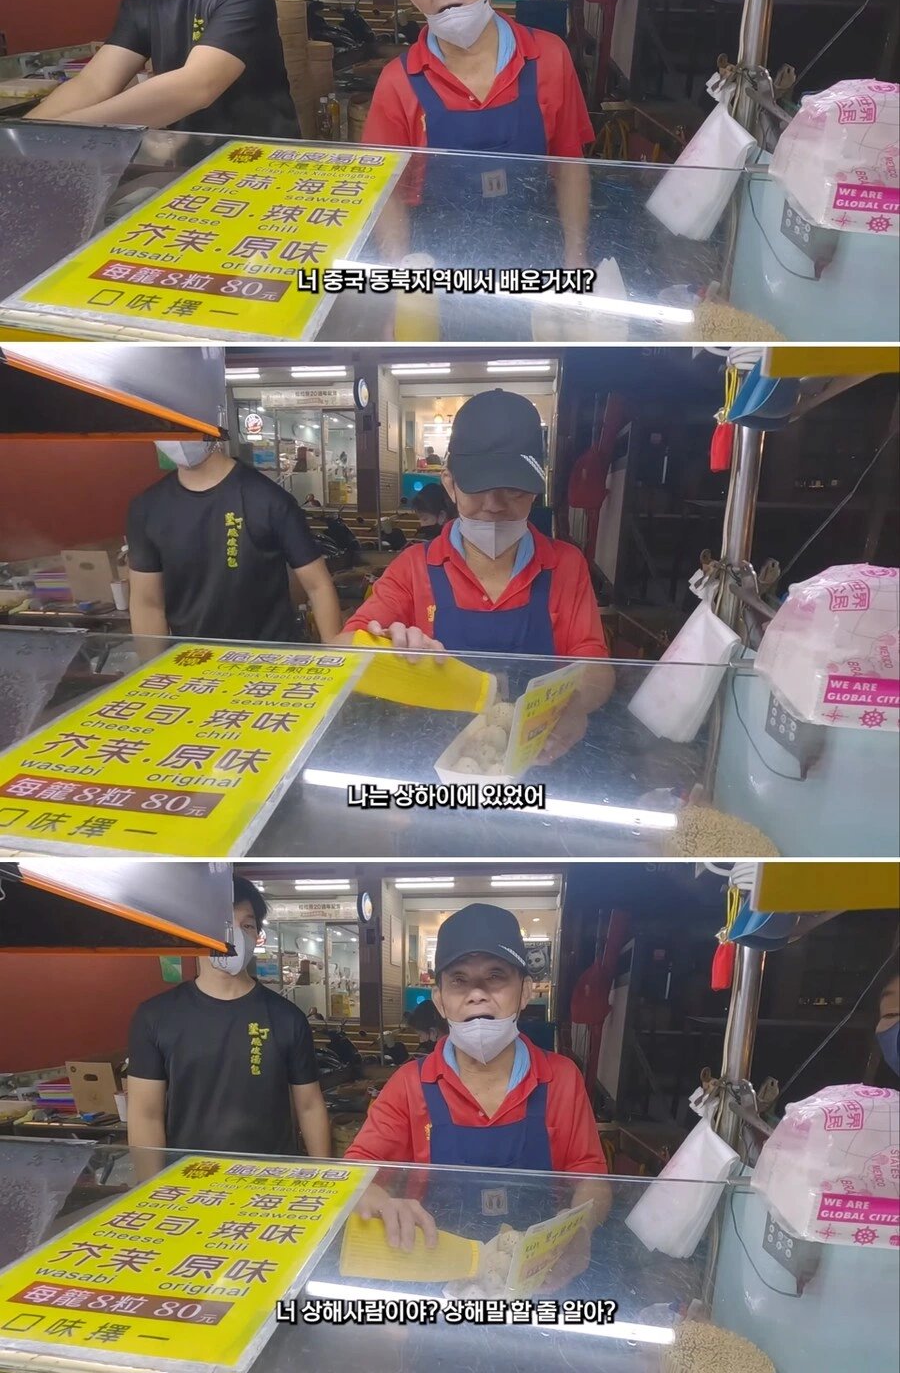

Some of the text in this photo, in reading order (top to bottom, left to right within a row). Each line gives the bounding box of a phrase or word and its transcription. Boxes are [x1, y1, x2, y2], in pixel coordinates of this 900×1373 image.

[190, 185, 363, 204] garlic seaweed
[839, 187, 883, 199] WE ARE
[836, 199, 879, 209] GLOBAL
[155, 212, 299, 233] cheese chili
[109, 247, 303, 275] wasabi origina
[830, 680, 878, 691] WE ARE
[125, 690, 316, 708] garlic seaweed
[827, 692, 872, 702] GLOBAL
[80, 720, 242, 740] cheese chili
[20, 759, 242, 788] wasabi original
[890, 1149, 900, 1179] STATES
[136, 1202, 322, 1220] garlic seaweed
[824, 1198, 869, 1209] WE ARE
[820, 1210, 865, 1220] GLOBAL
[93, 1230, 250, 1251] cheese chili
[35, 1267, 250, 1297] wasabi original
